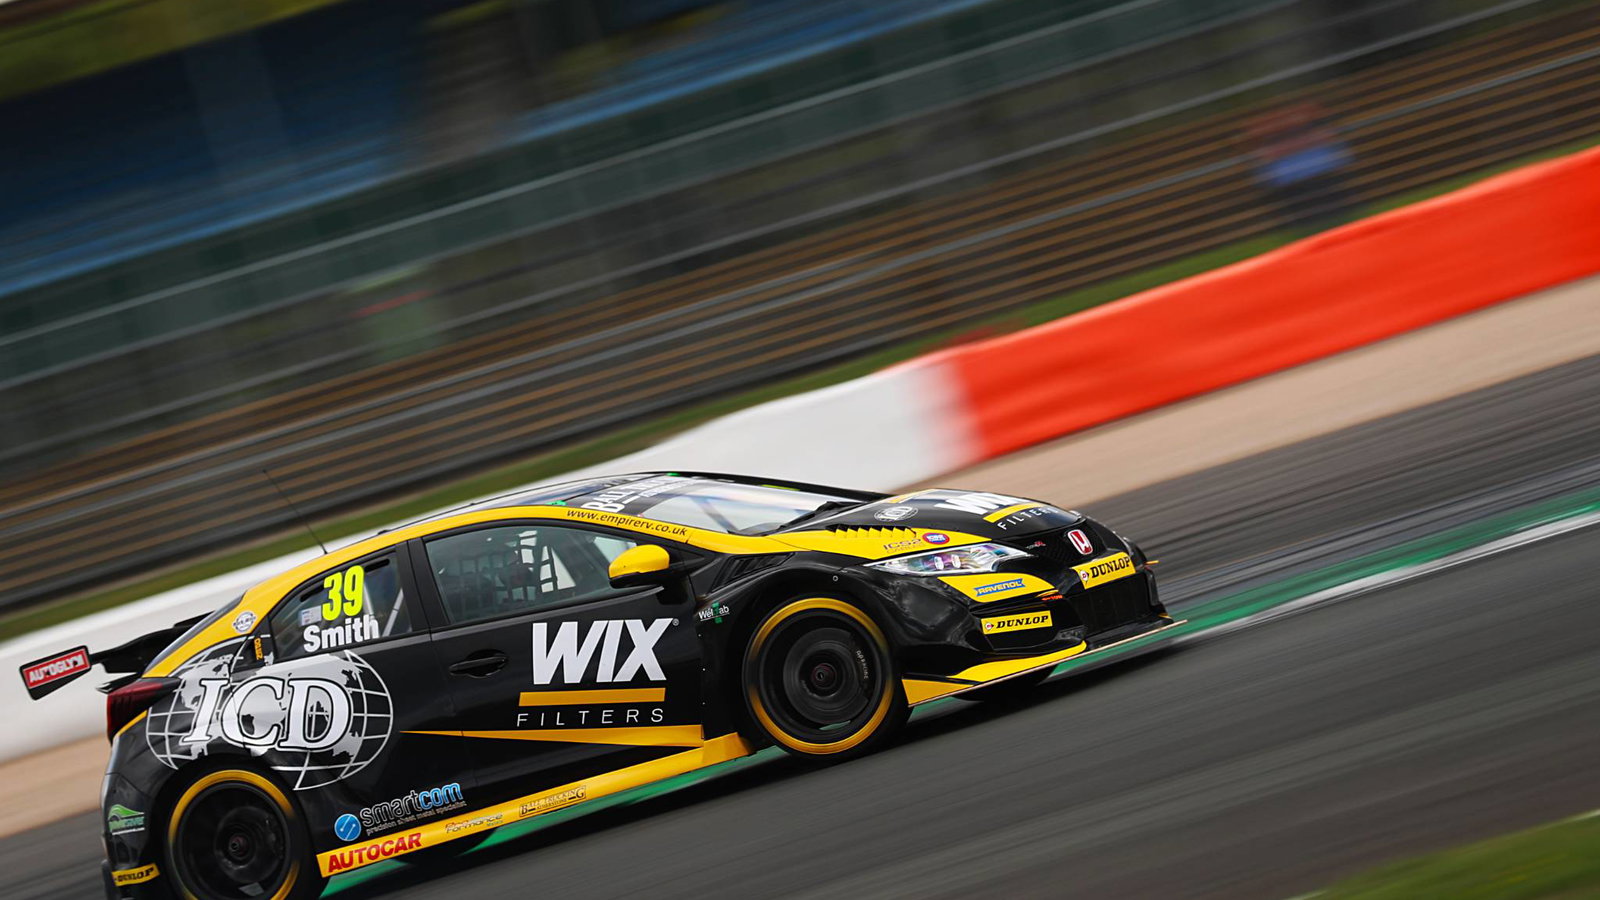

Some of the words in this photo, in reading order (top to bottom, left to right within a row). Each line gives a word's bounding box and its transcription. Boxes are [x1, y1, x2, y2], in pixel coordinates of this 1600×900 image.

[566, 509, 688, 536] www.empirerv.co.uk
[1090, 556, 1130, 579] DUNLOP
[322, 565, 364, 620] 39
[303, 614, 379, 652] Smith
[996, 615, 1049, 629] DUNLOP
[532, 617, 674, 685] WIX
[182, 677, 351, 749] ICD
[516, 708, 664, 727] FILTERS
[360, 782, 463, 827] smartcom
[328, 832, 422, 873] AUTOCAR
